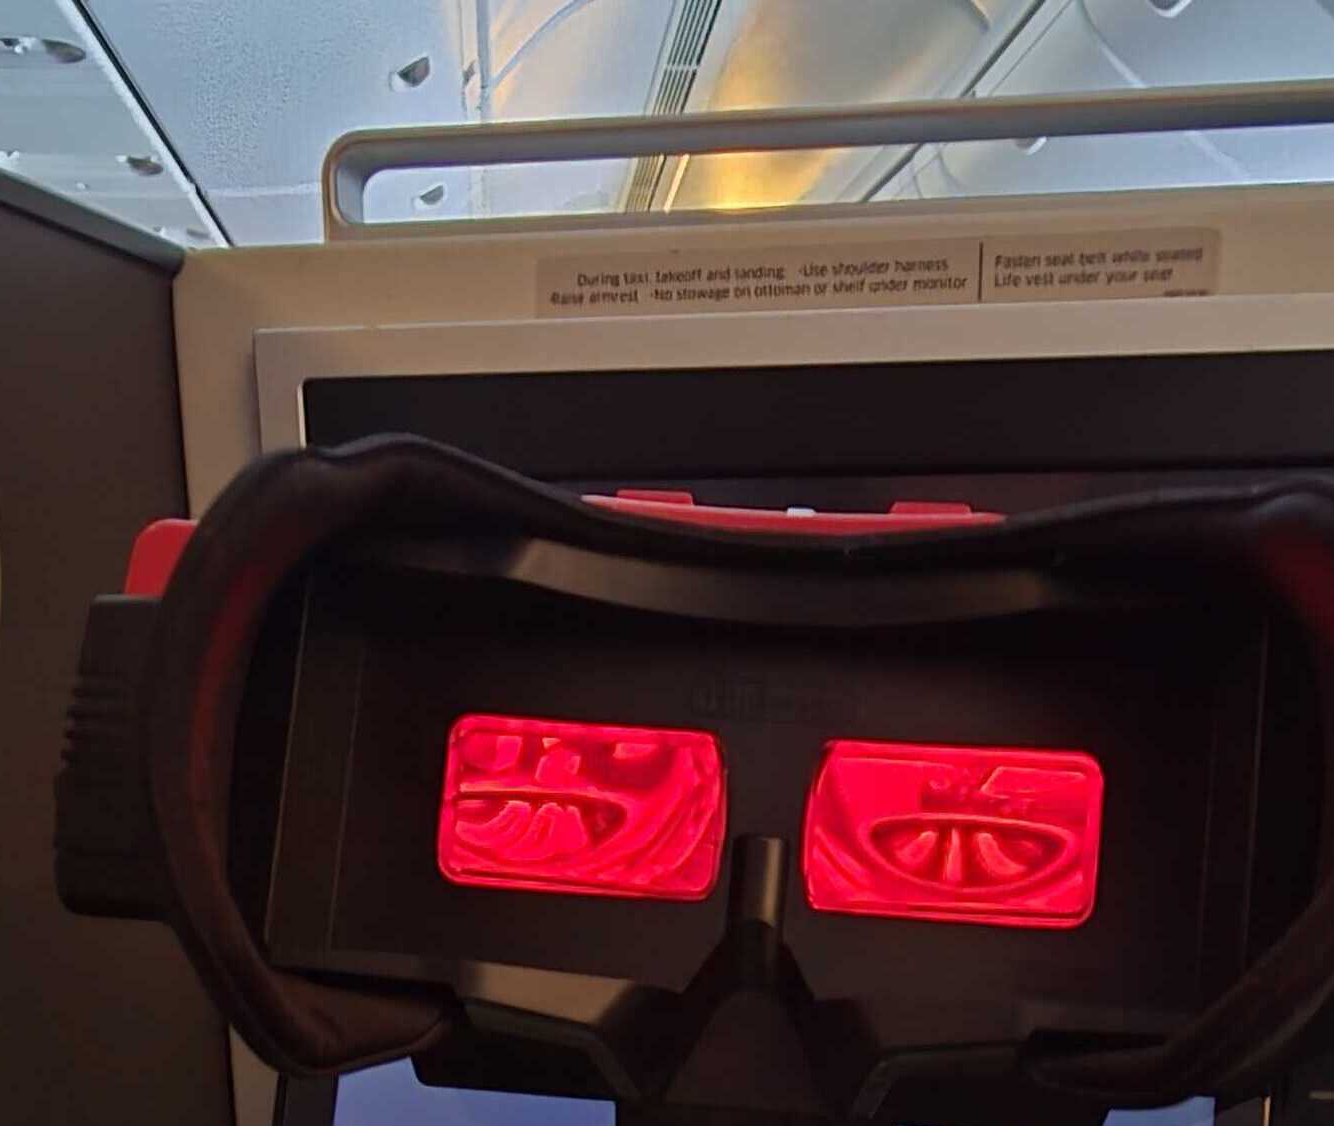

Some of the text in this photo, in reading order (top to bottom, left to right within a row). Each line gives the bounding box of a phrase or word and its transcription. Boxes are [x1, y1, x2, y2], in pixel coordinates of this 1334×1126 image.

[994, 254, 1041, 269] Fasten
[577, 272, 620, 288] During
[706, 266, 731, 281] and
[734, 265, 785, 282] landing
[831, 260, 890, 276] shoulder
[894, 258, 949, 273] harness
[994, 271, 1021, 288] Life
[1026, 271, 1054, 286] vest
[1058, 270, 1100, 286] under
[1106, 270, 1138, 287] your
[733, 284, 751, 299] on
[754, 283, 811, 298] ottoman
[813, 283, 827, 296] or
[832, 278, 866, 294] shelf
[869, 278, 908, 293] under
[913, 277, 968, 291] monitor
